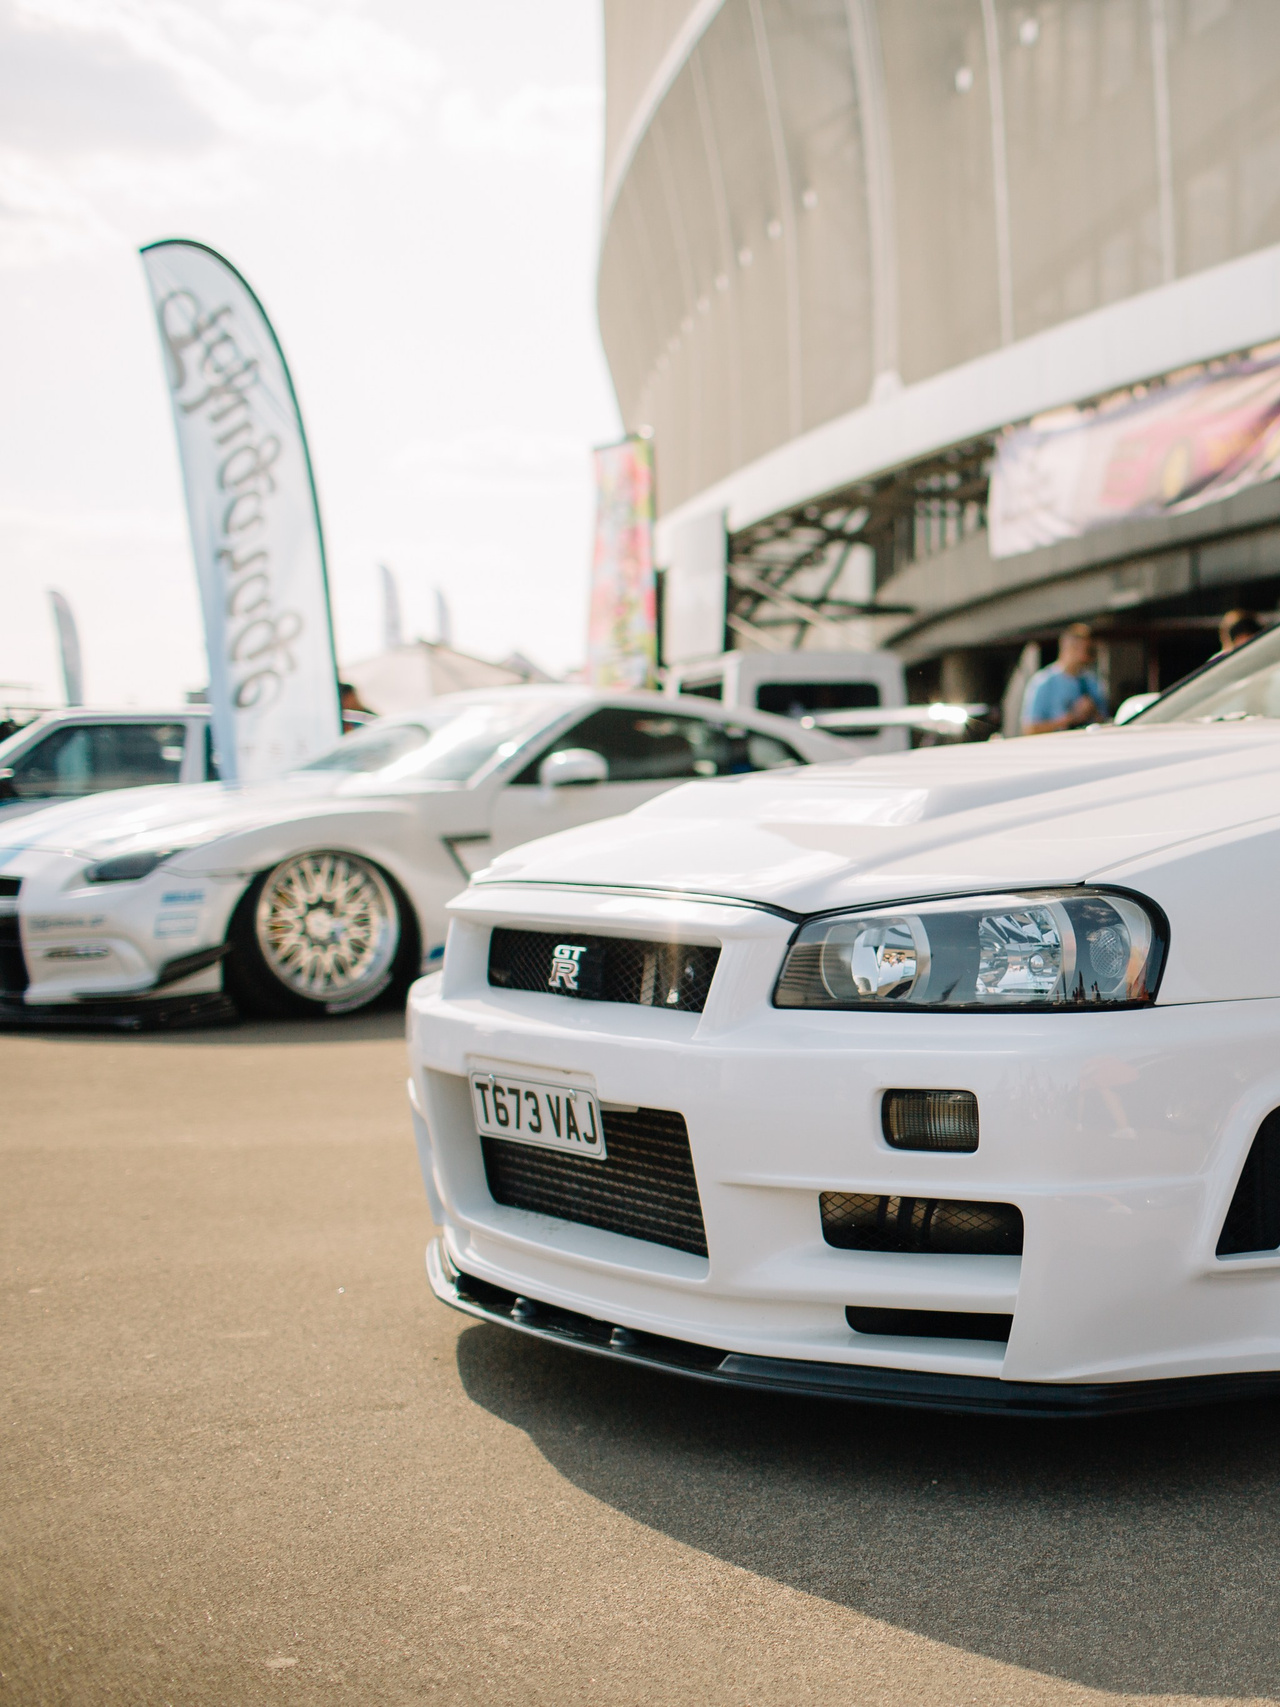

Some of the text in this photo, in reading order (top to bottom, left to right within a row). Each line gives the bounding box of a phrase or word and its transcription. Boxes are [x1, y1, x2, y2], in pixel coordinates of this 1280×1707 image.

[553, 944, 587, 960] GT
[548, 957, 580, 990] R
[475, 1082, 598, 1145] T673 VAJ
